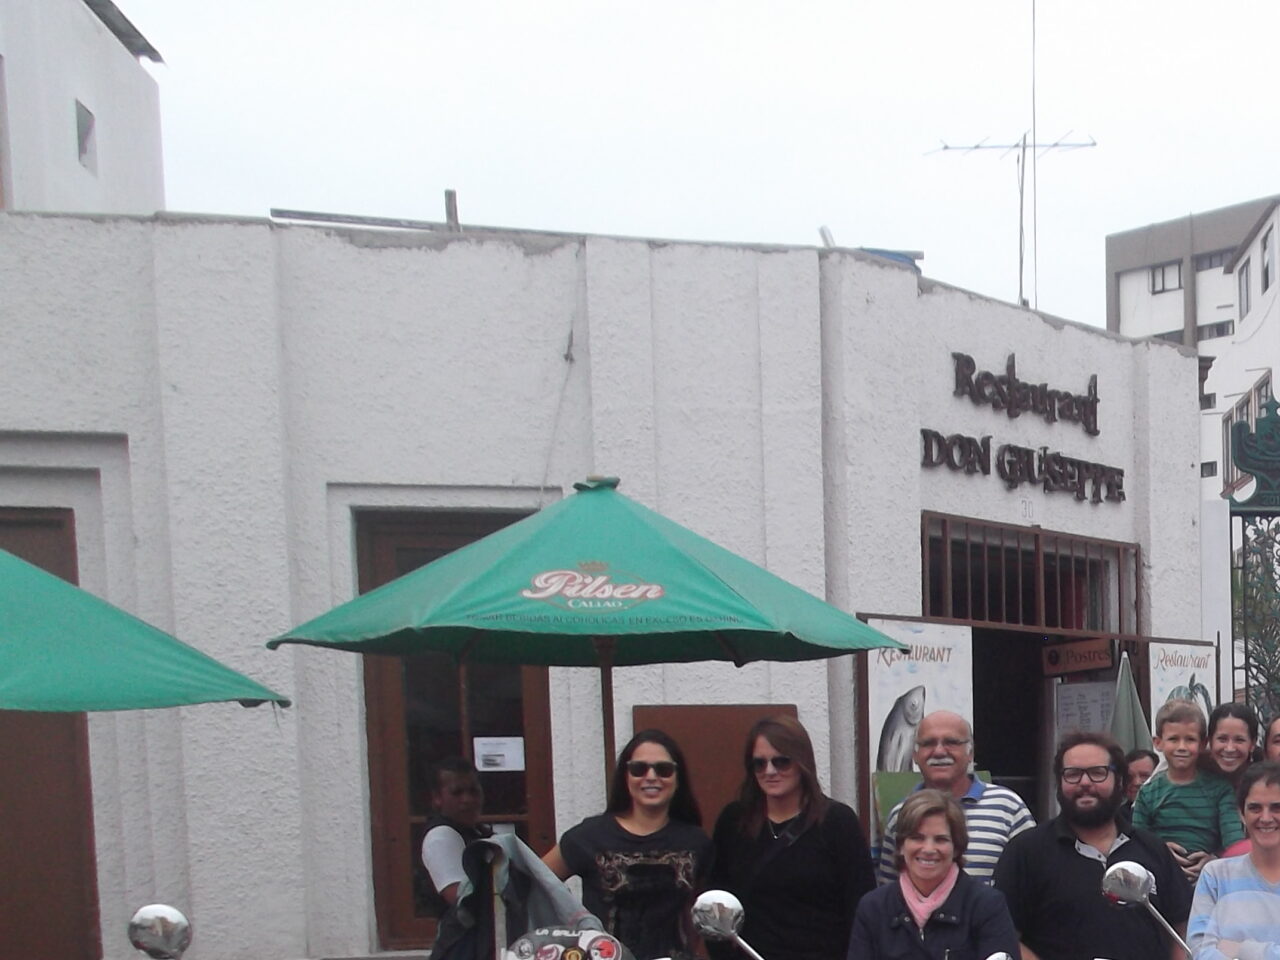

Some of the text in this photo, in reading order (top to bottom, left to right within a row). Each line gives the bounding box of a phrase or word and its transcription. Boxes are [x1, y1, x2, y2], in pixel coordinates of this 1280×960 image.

[920, 427, 993, 477] DON
[520, 569, 665, 600] Pilsen
[567, 598, 624, 610] CALLAO
[1066, 647, 1111, 665] Postres
[1153, 647, 1213, 672] Restaurant
